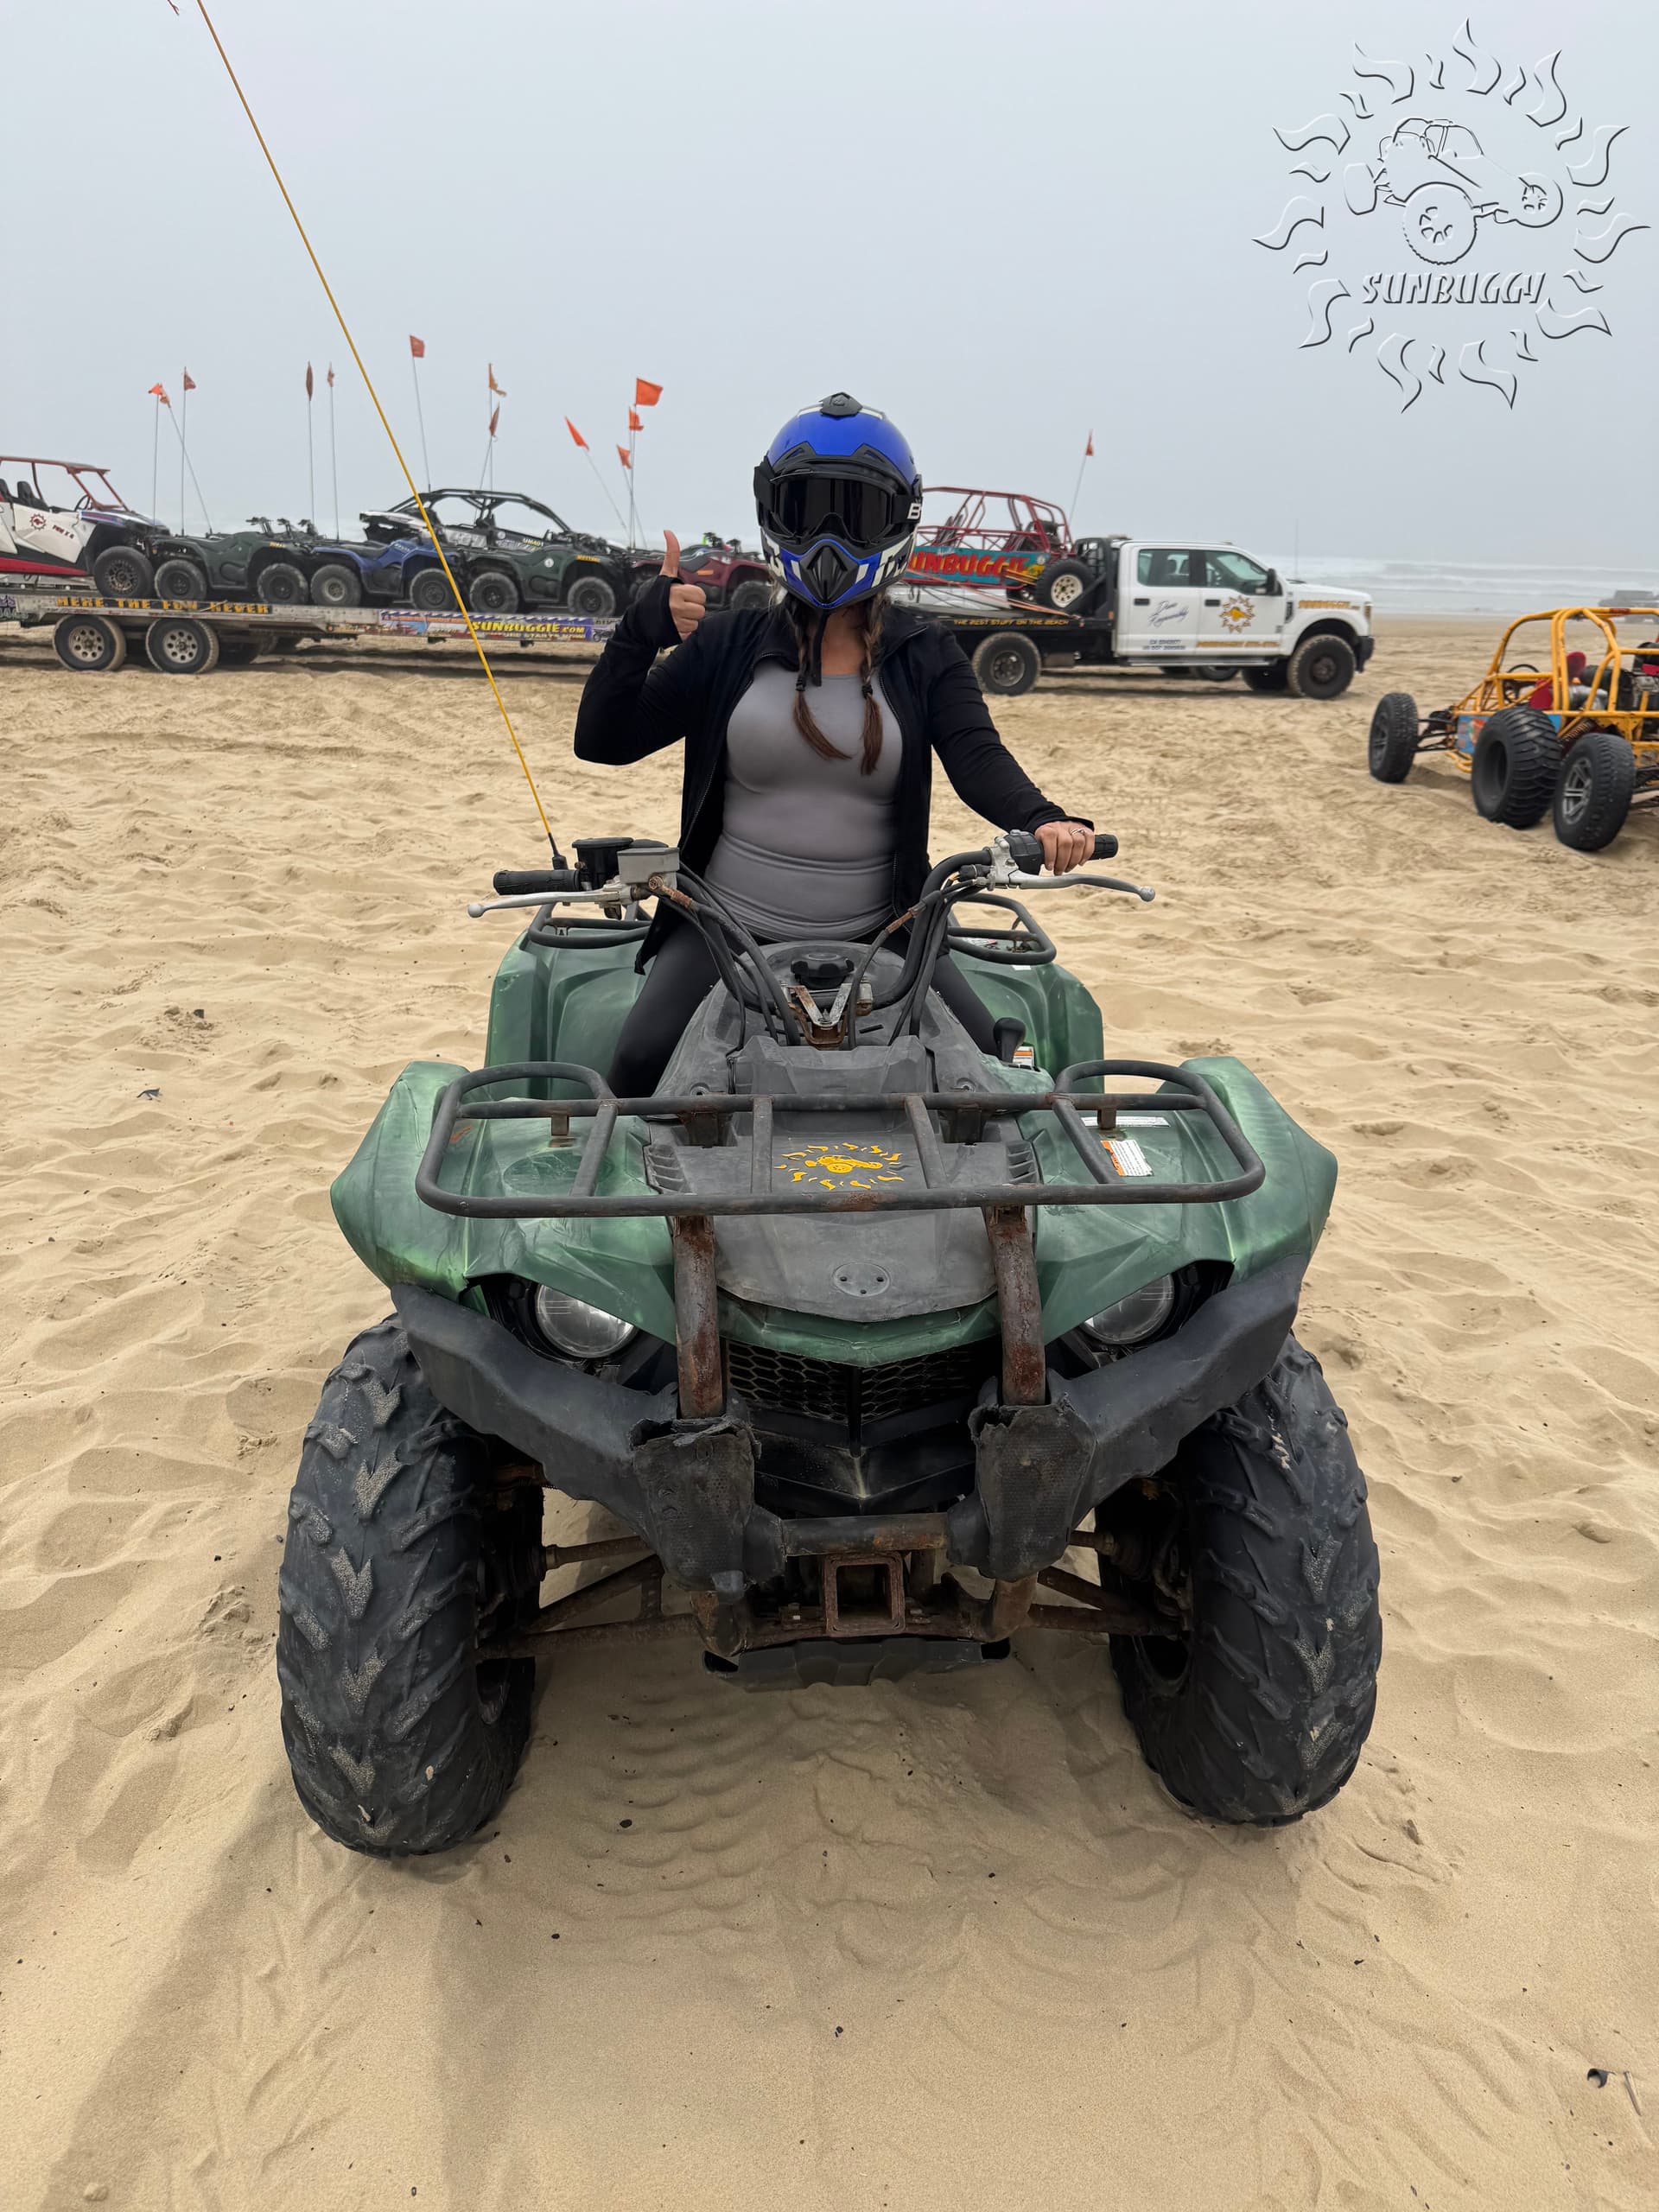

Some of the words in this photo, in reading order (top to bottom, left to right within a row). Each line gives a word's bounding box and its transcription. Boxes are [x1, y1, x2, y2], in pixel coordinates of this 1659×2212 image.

[907, 550, 1030, 577] UNBUGGIE
[115, 597, 151, 609] THE
[209, 601, 270, 614] NEVER
